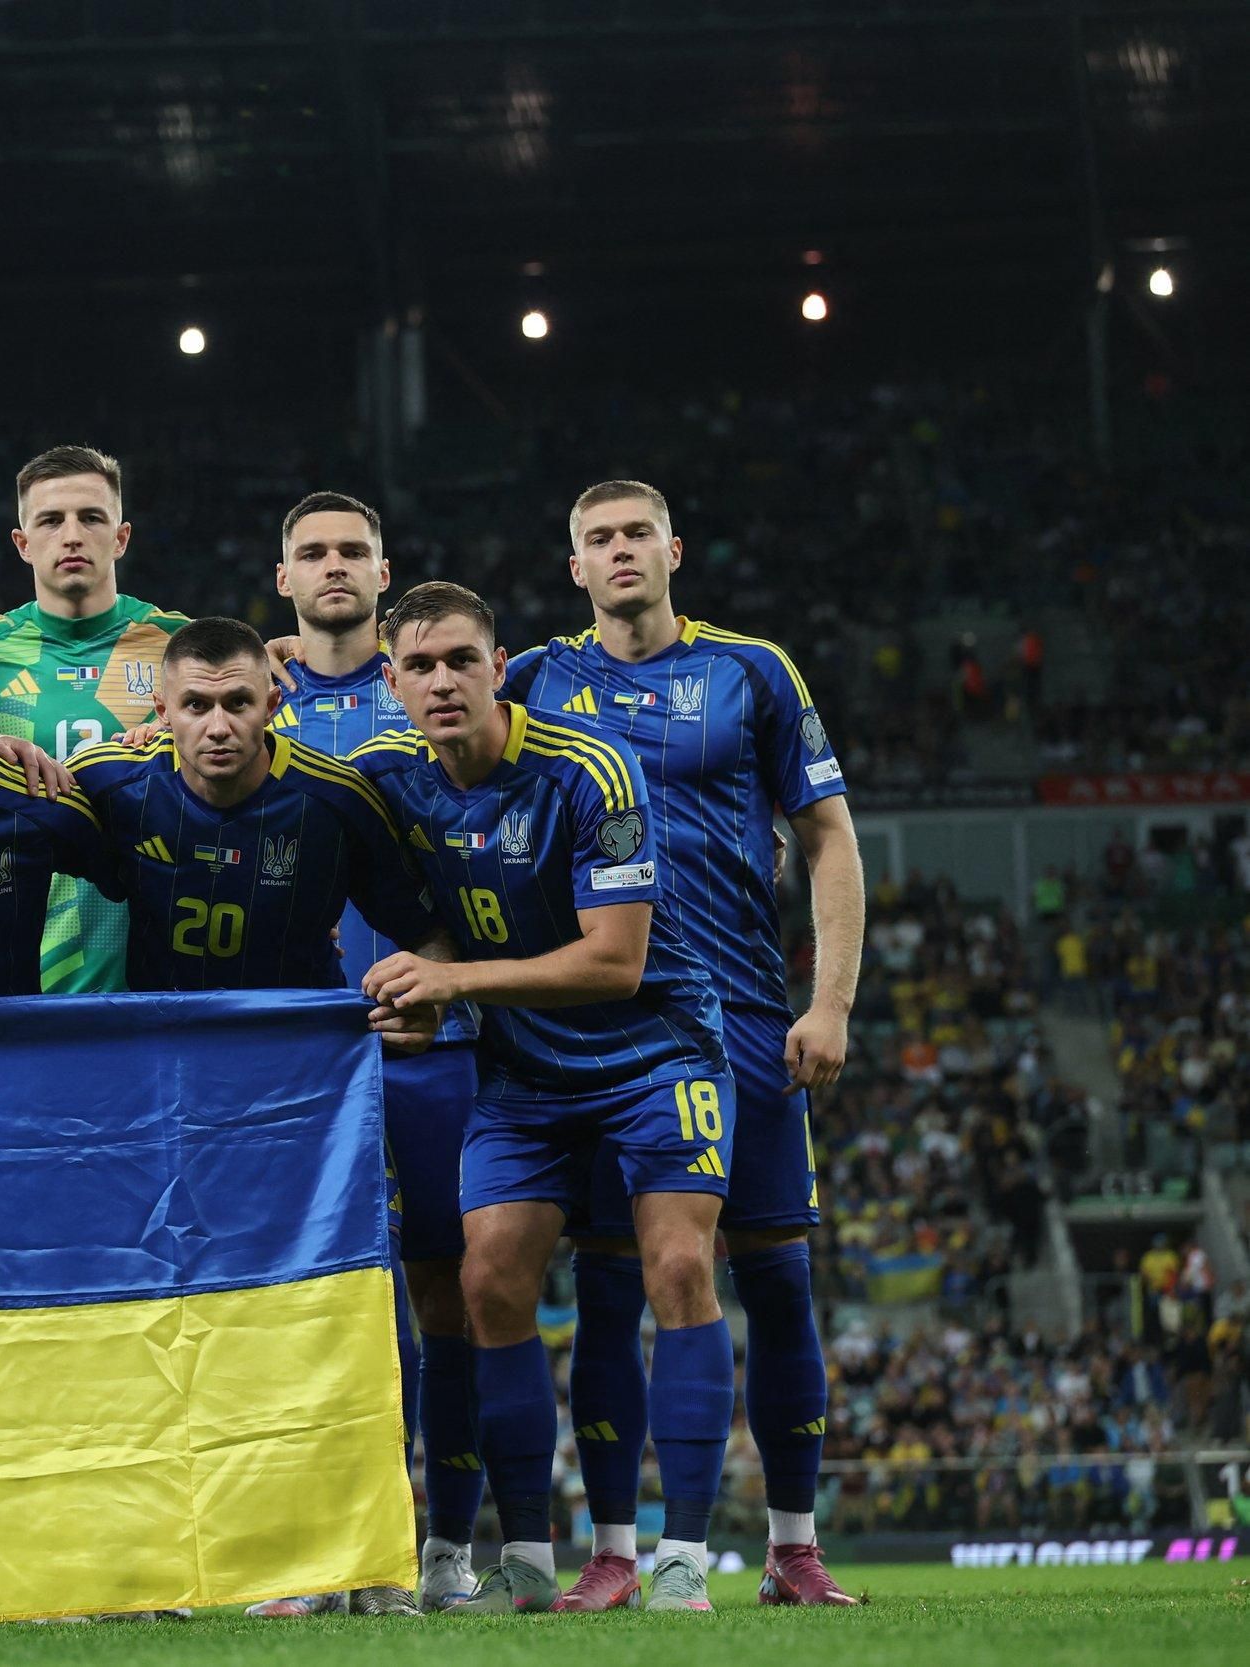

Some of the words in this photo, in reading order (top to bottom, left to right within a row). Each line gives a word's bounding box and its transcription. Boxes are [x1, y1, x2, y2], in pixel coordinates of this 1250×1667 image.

[671, 714, 701, 722] UKRAINE
[260, 879, 292, 887] UKRAINE
[172, 896, 245, 958] 20
[458, 886, 509, 944] 18
[674, 1080, 723, 1142] 18
